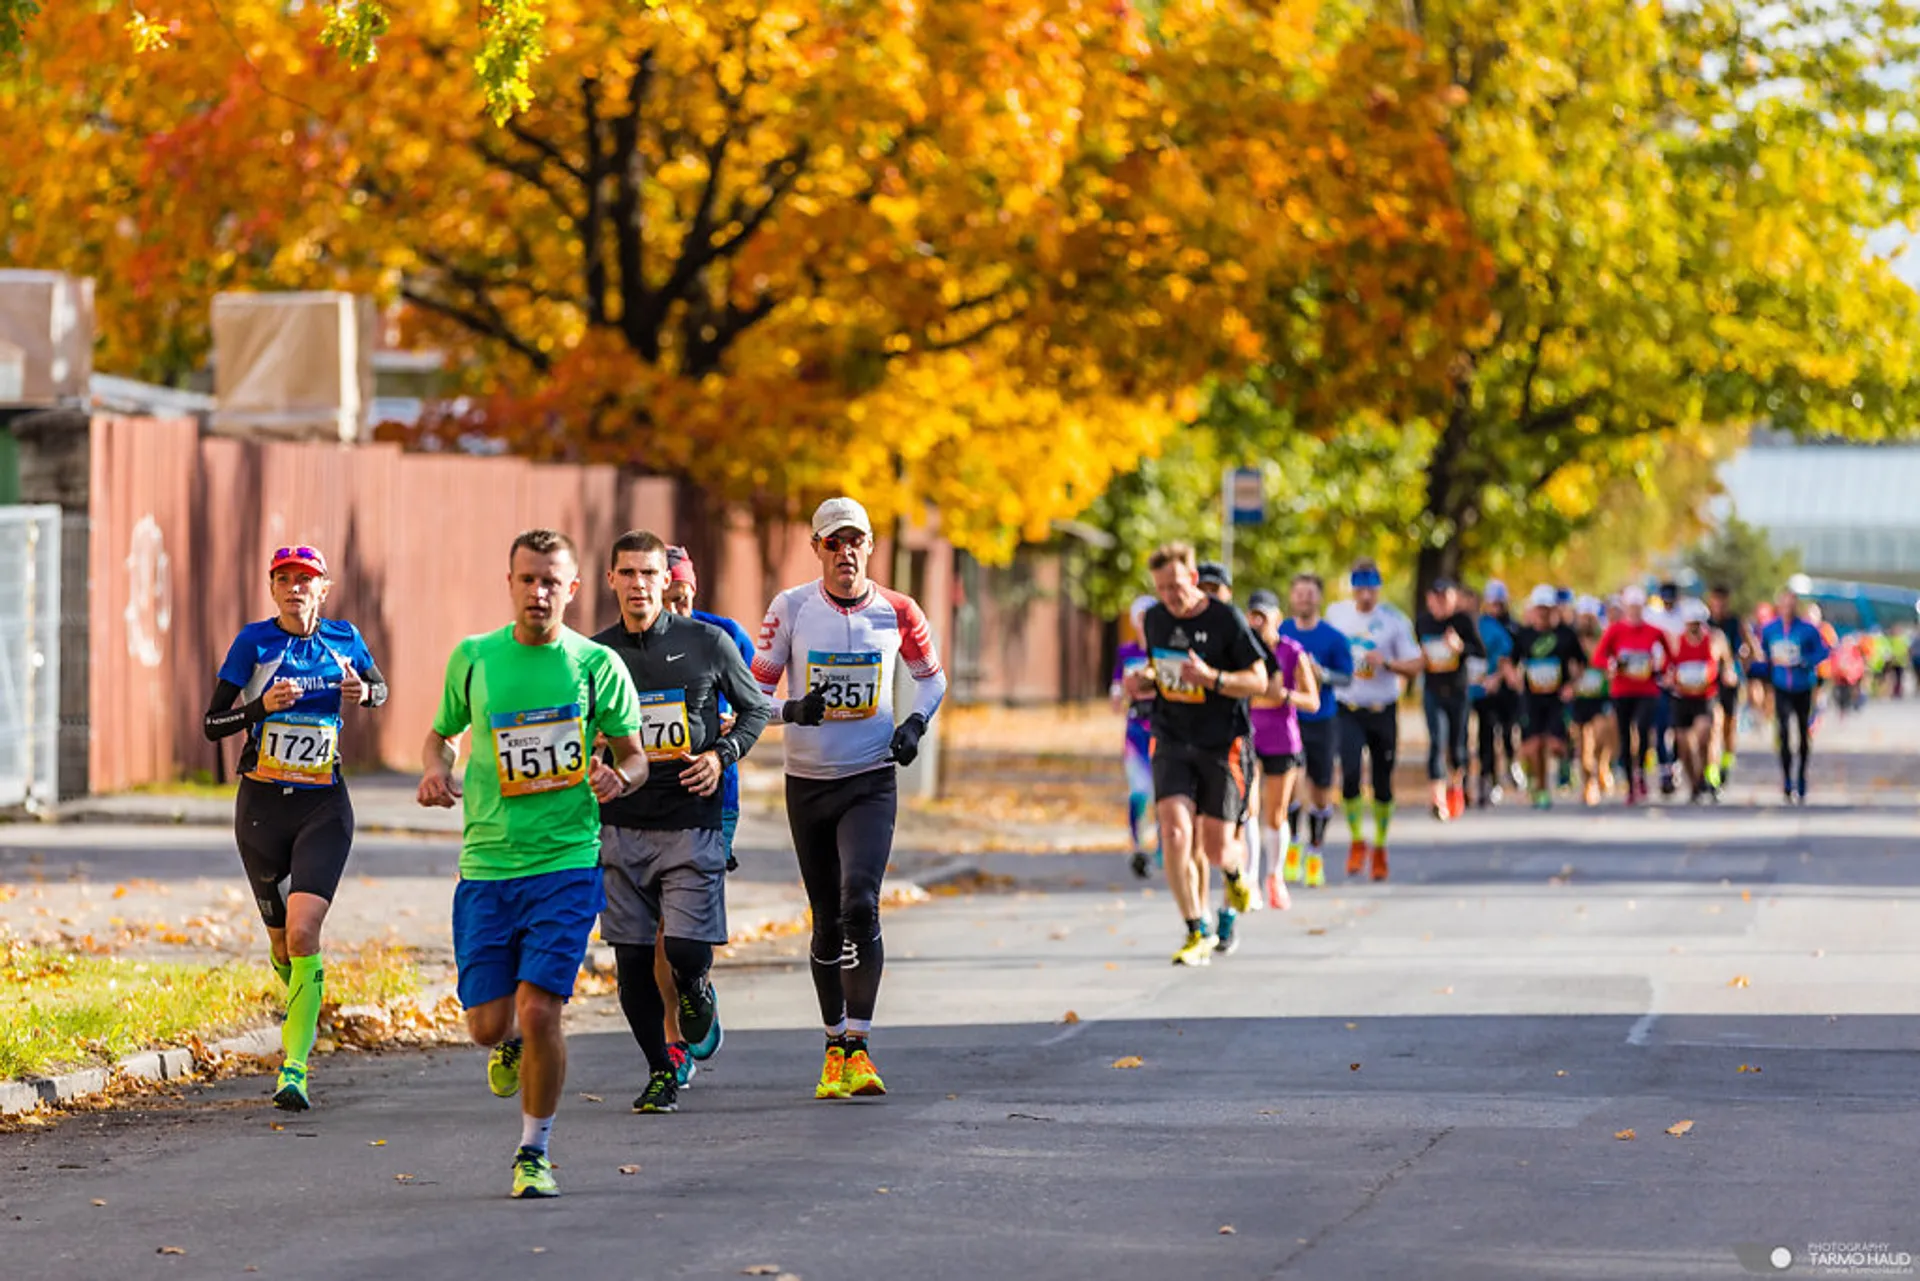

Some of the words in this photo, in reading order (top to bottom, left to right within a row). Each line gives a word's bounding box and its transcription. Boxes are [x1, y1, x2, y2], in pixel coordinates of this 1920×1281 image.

[273, 676, 325, 690] EONIA
[268, 732, 331, 763] 1724
[640, 721, 686, 749] 70
[500, 740, 582, 781] 1513
